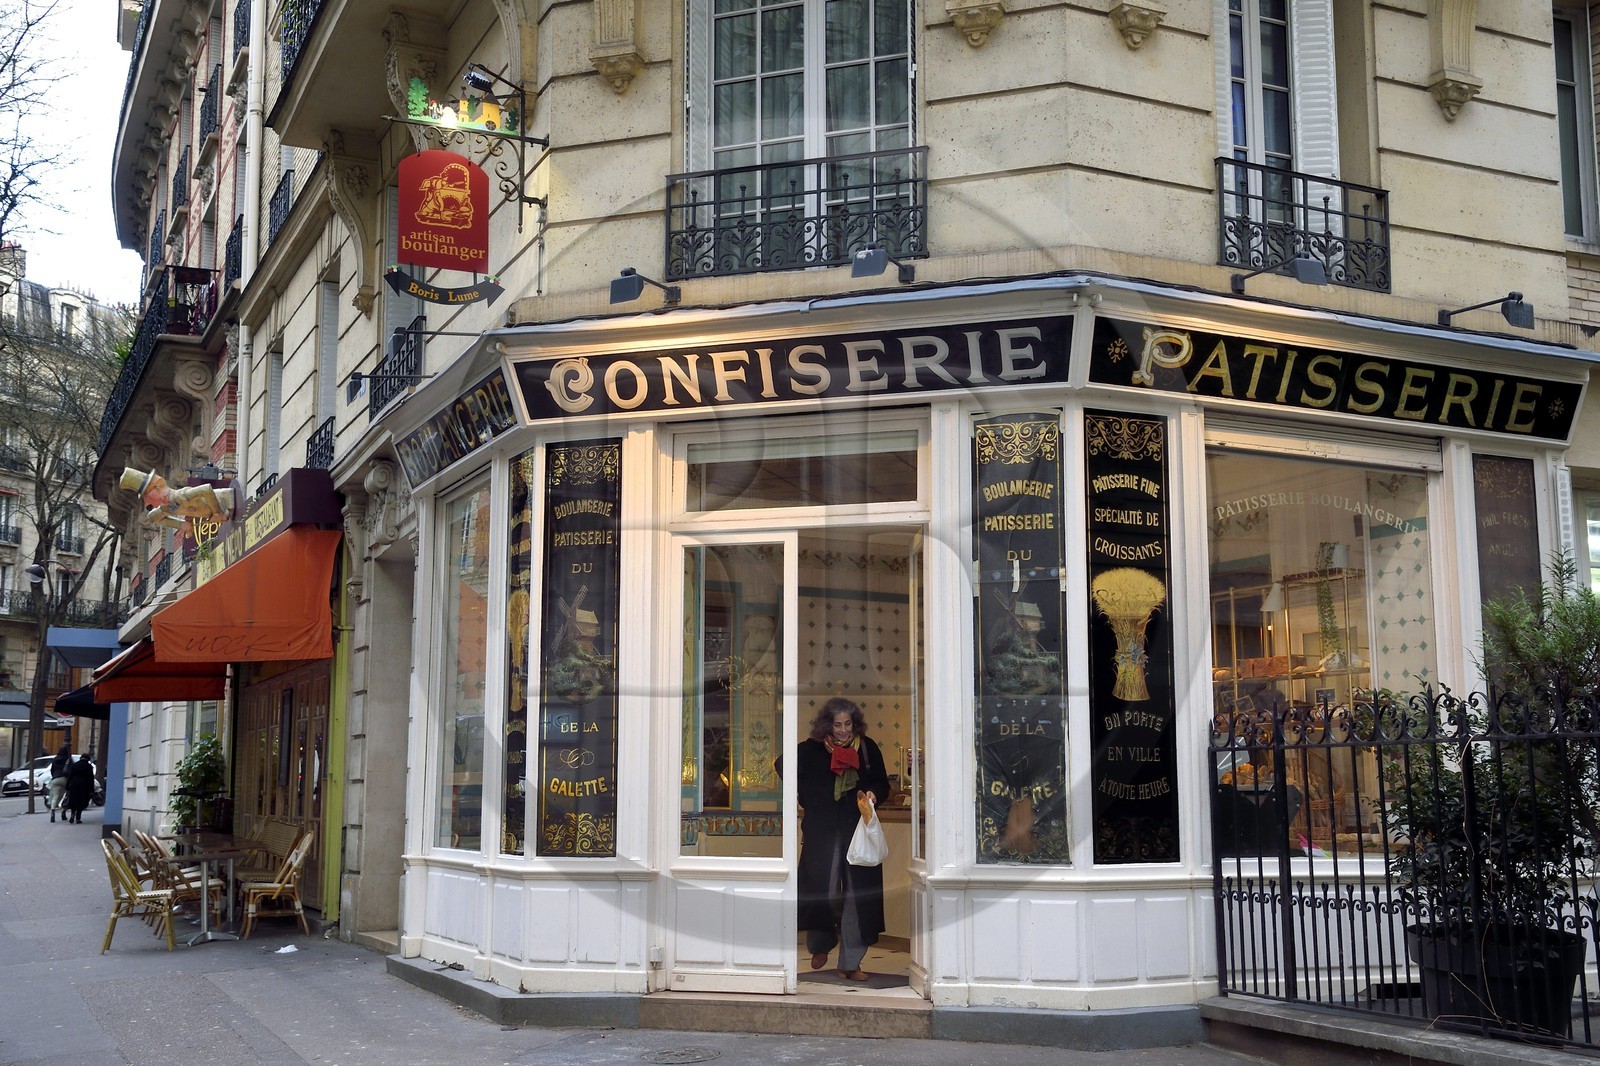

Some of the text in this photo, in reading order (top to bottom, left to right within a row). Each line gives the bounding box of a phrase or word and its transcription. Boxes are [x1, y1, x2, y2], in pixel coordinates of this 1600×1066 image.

[410, 230, 455, 244] artisan
[401, 236, 486, 261] boulanger
[407, 281, 440, 300] Boris
[544, 326, 1047, 413] CONFISERIE
[1131, 326, 1543, 433] PATISSERIE
[399, 374, 517, 484] BOULANGERIE
[983, 479, 1054, 502] BOULANGERIE
[1140, 477, 1161, 498] FINE
[554, 498, 613, 520] BOULANGERIE
[1215, 491, 1305, 520] PÂTISSERIE
[985, 512, 1054, 531] PATISSERIE
[1094, 506, 1159, 527] SPÉCIALITÉ DE
[554, 529, 613, 547] PATISSERIE
[1094, 536, 1163, 560] CROISSANTS
[1007, 549, 1032, 561] DU
[571, 562, 593, 574] DU
[560, 722, 578, 734] DE
[583, 722, 600, 734] LA
[1000, 723, 1046, 736] DE LA
[1104, 710, 1164, 732] ON PORTE
[1107, 746, 1161, 762] EN VILLE
[549, 776, 609, 797] GALETTE
[1138, 776, 1171, 800] HEURE
